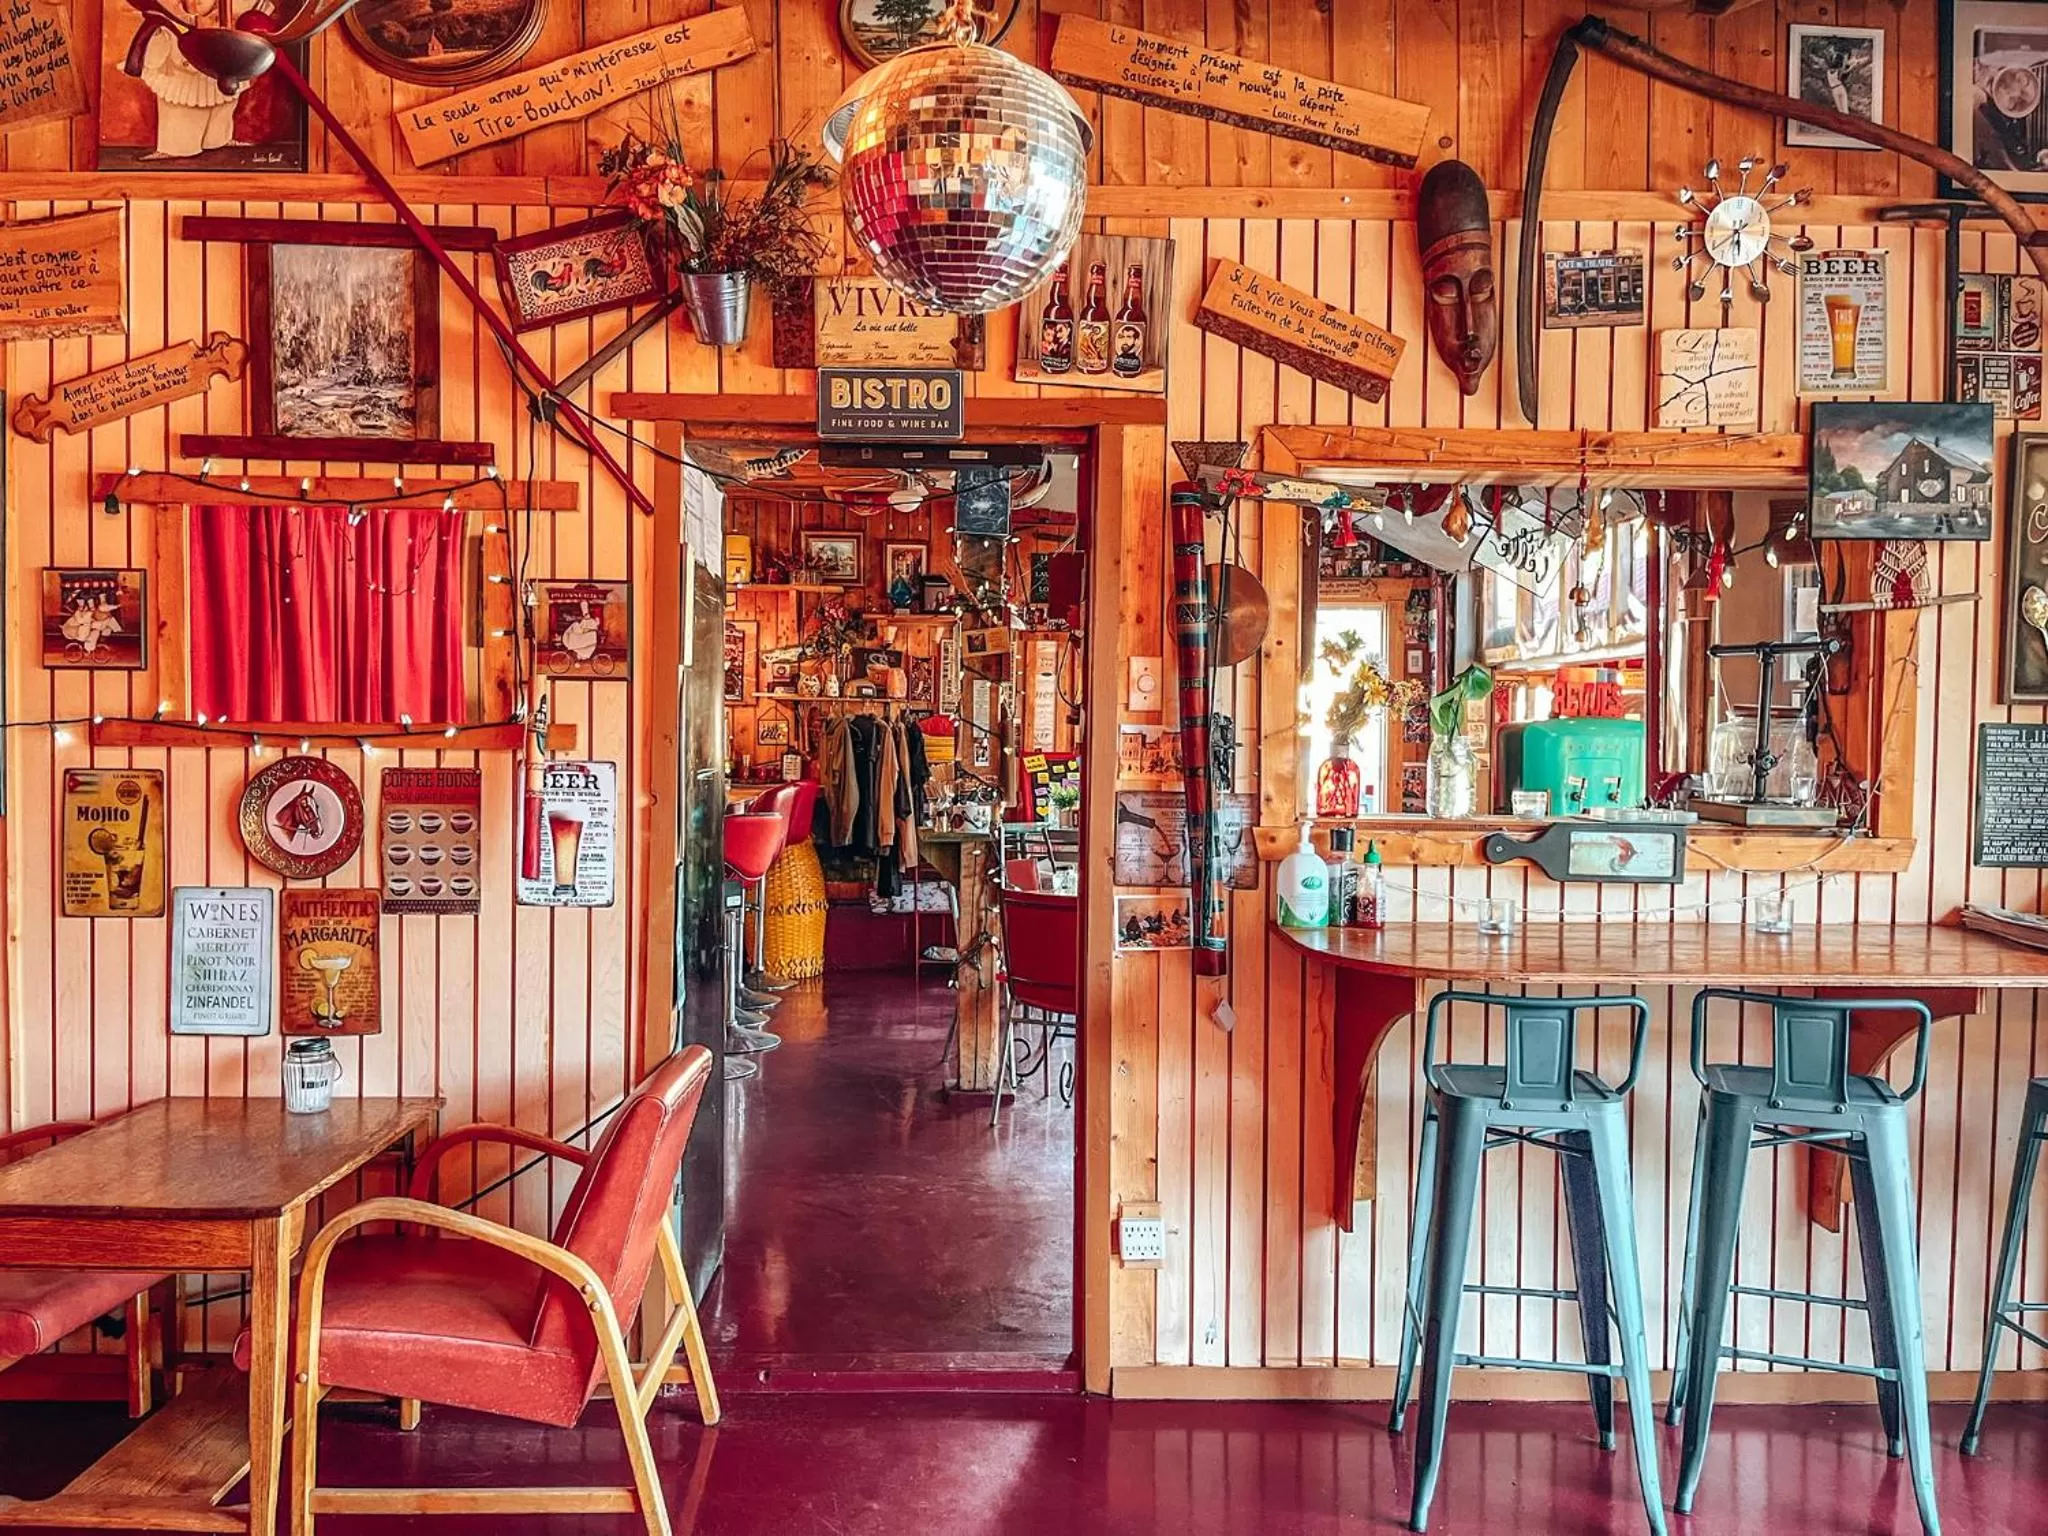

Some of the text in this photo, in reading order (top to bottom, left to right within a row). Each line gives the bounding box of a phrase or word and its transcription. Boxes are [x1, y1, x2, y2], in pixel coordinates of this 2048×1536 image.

[46, 52, 70, 72] dans
[1110, 28, 1126, 44] Le
[1137, 36, 1189, 59] moment
[1200, 53, 1245, 75] présent
[1263, 69, 1283, 82] est
[1294, 77, 1306, 93] la
[413, 113, 436, 131] La
[443, 100, 480, 123] seule
[489, 83, 530, 105] arme
[538, 69, 562, 91] qui
[664, 25, 692, 45] est
[1190, 64, 1197, 76] à
[1205, 69, 1229, 86] tout
[1239, 80, 1287, 100] nouveau
[450, 128, 470, 148] le
[32, 249, 82, 265] comme
[1803, 260, 1880, 275] BEER
[1229, 268, 1244, 286] Si
[1245, 275, 1259, 296] la
[1349, 324, 1362, 339] du
[853, 321, 918, 333] La vie est belle
[1279, 315, 1293, 329] de
[124, 363, 157, 379] donner
[830, 377, 951, 410] BISTRO
[2014, 391, 2041, 410] Coffee
[71, 410, 94, 425] dans
[832, 419, 950, 428] FINE FOOD & WINE BAR
[383, 772, 480, 788] COFFEE HOUSE
[77, 805, 130, 824] Mojito
[187, 927, 258, 939] CABERNET
[284, 927, 377, 950] MARGARITA
[195, 942, 249, 953] MERLOT
[186, 954, 256, 967] PINOT NOIR
[194, 969, 248, 981] SHIRAZ
[185, 984, 255, 993] CHARDONNAY
[186, 995, 255, 1009] ZINFANDEL
